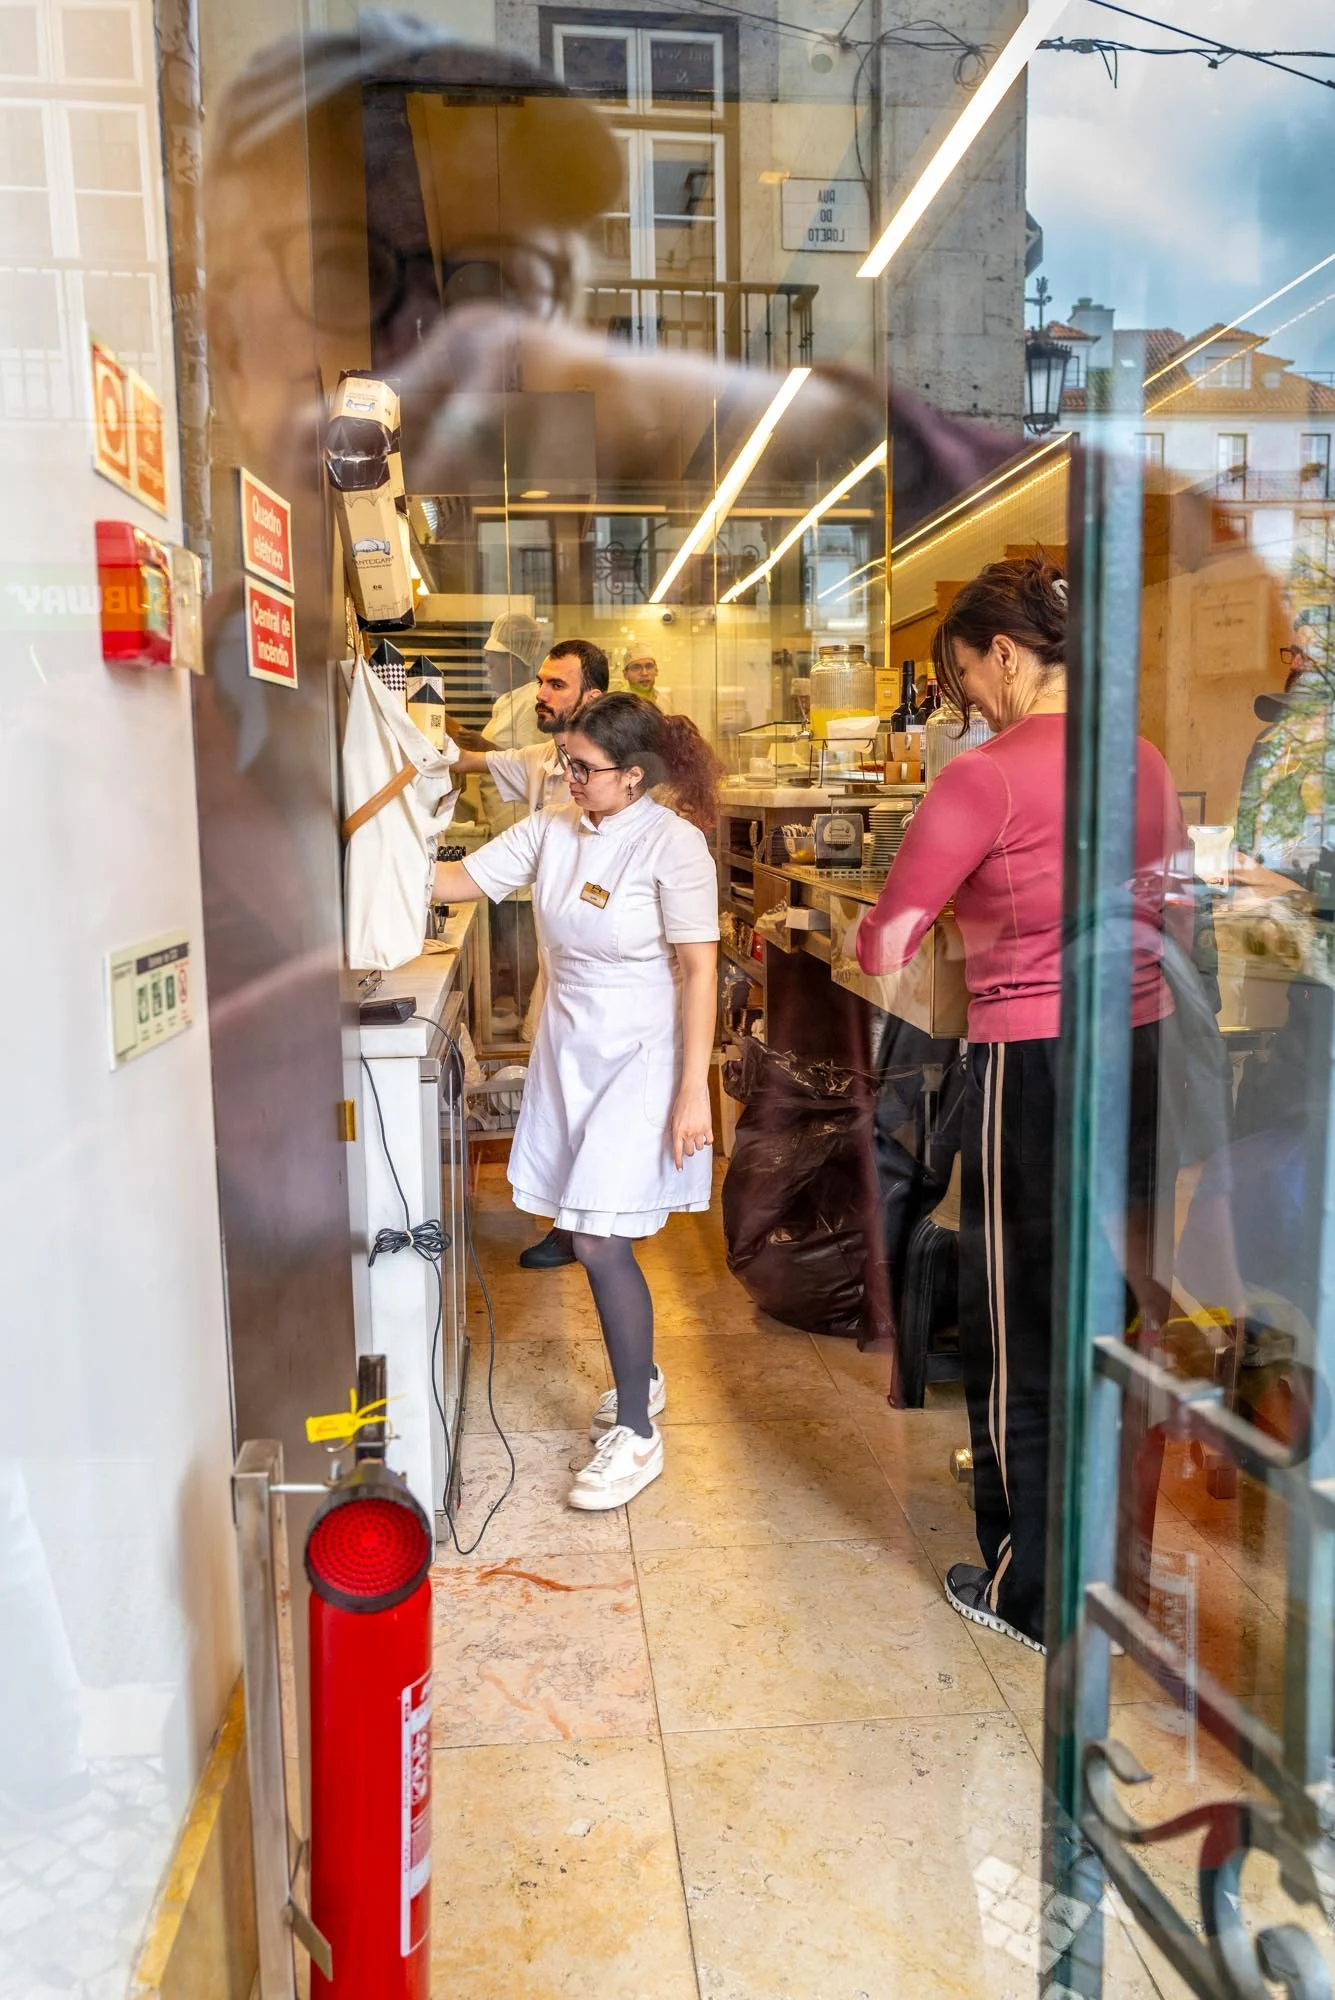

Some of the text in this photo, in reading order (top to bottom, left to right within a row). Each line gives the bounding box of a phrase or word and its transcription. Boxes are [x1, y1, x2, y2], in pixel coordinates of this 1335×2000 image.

[252, 495, 282, 537] Quadro
[253, 534, 284, 571] elétrico
[252, 600, 291, 638] Central de
[257, 635, 290, 668] incêndio
